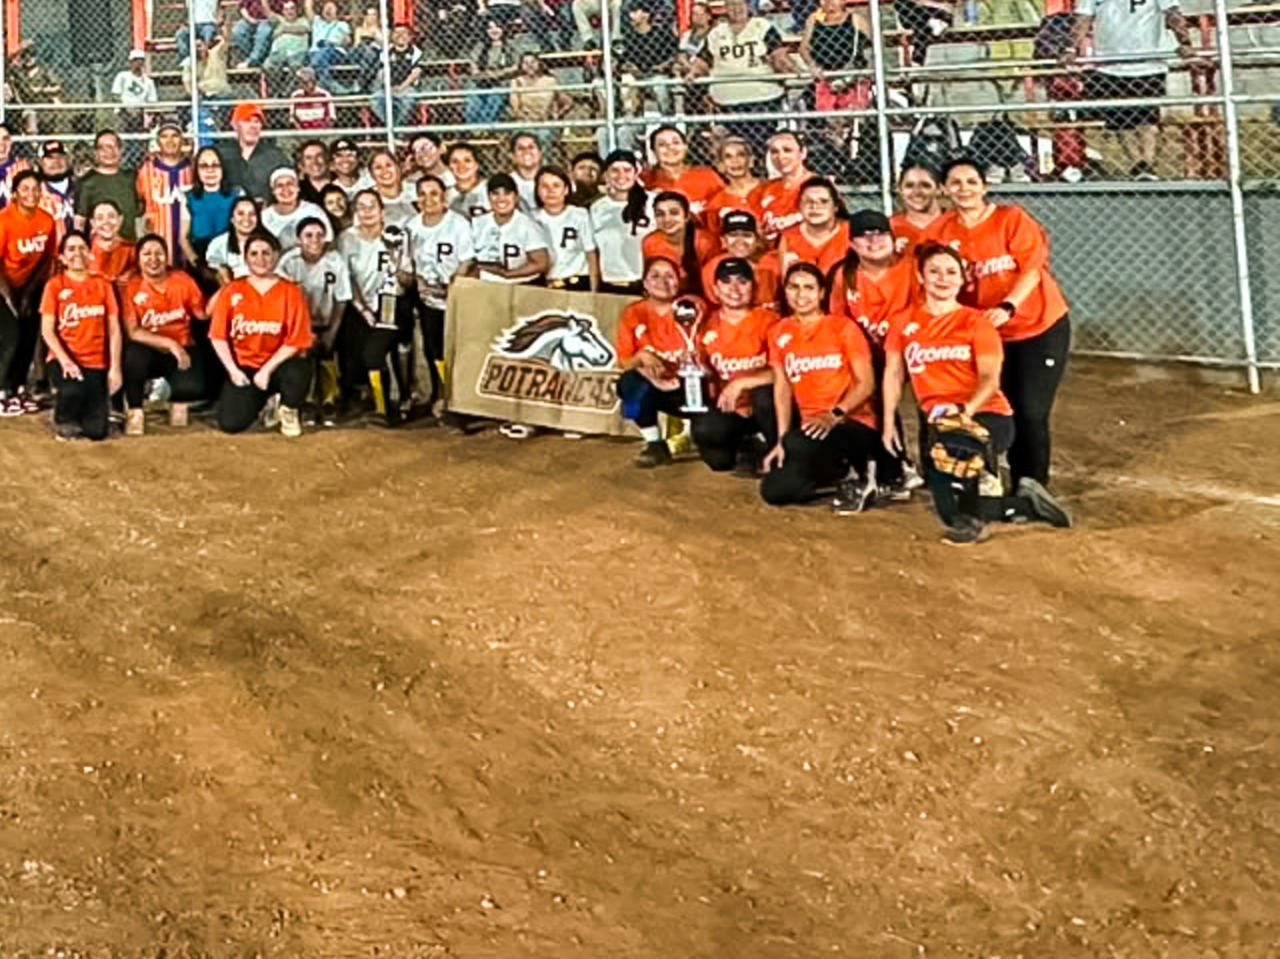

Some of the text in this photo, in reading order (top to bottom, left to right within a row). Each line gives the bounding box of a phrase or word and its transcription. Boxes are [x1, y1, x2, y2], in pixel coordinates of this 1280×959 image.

[719, 41, 758, 61] POT
[630, 215, 650, 236] P
[17, 235, 48, 253] UAT
[560, 227, 577, 248] P
[437, 242, 453, 263] P
[503, 243, 520, 268] P
[324, 271, 336, 293] P
